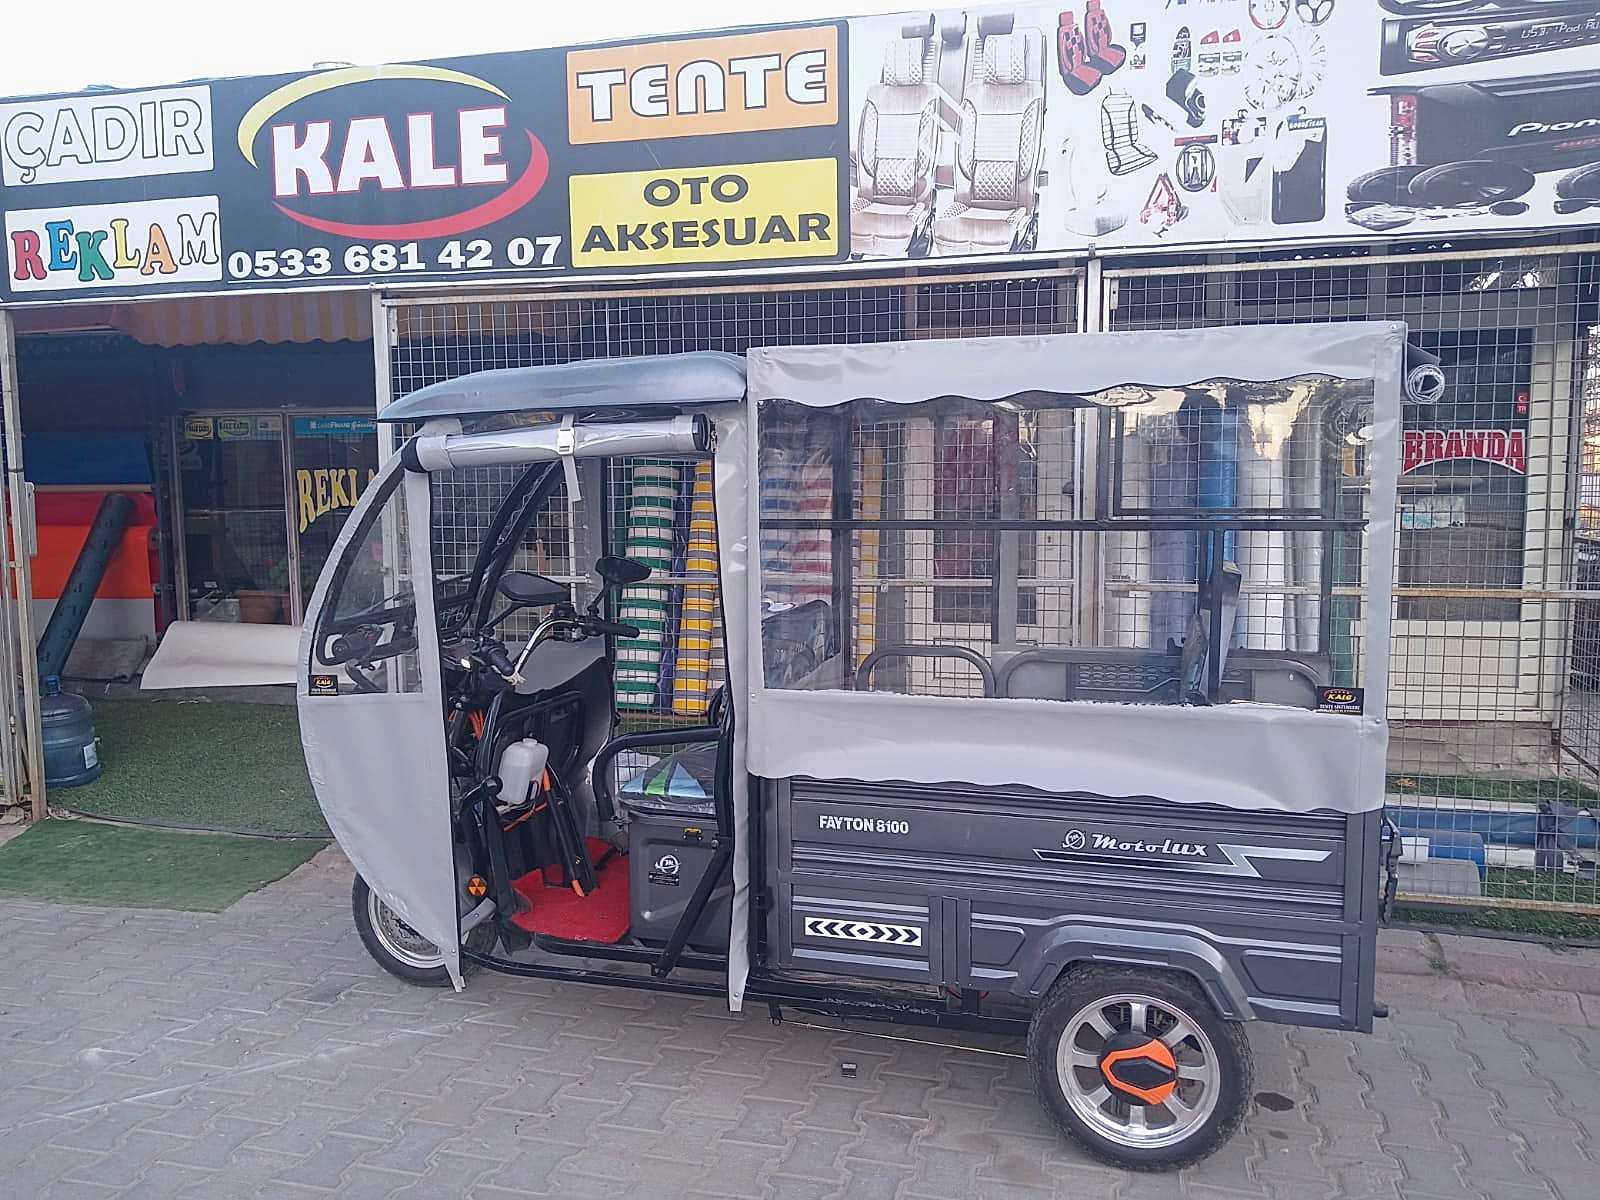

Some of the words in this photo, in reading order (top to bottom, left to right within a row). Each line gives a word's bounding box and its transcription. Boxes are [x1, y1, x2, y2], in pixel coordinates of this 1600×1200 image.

[576, 49, 827, 122] TENTE
[5, 98, 204, 184] ÇADIR
[272, 106, 509, 198] KALE
[643, 174, 749, 207] OTO
[11, 211, 220, 282] REKLAM
[581, 212, 831, 252] AKSESUAR
[227, 247, 332, 279] 0533
[344, 243, 426, 272] 681
[437, 239, 493, 269] 42
[507, 235, 562, 266] 07
[1402, 429, 1526, 475] BRANDA
[819, 815, 874, 832] FAYTON
[876, 819, 909, 834] 8100
[1091, 833, 1208, 857] Motolux
